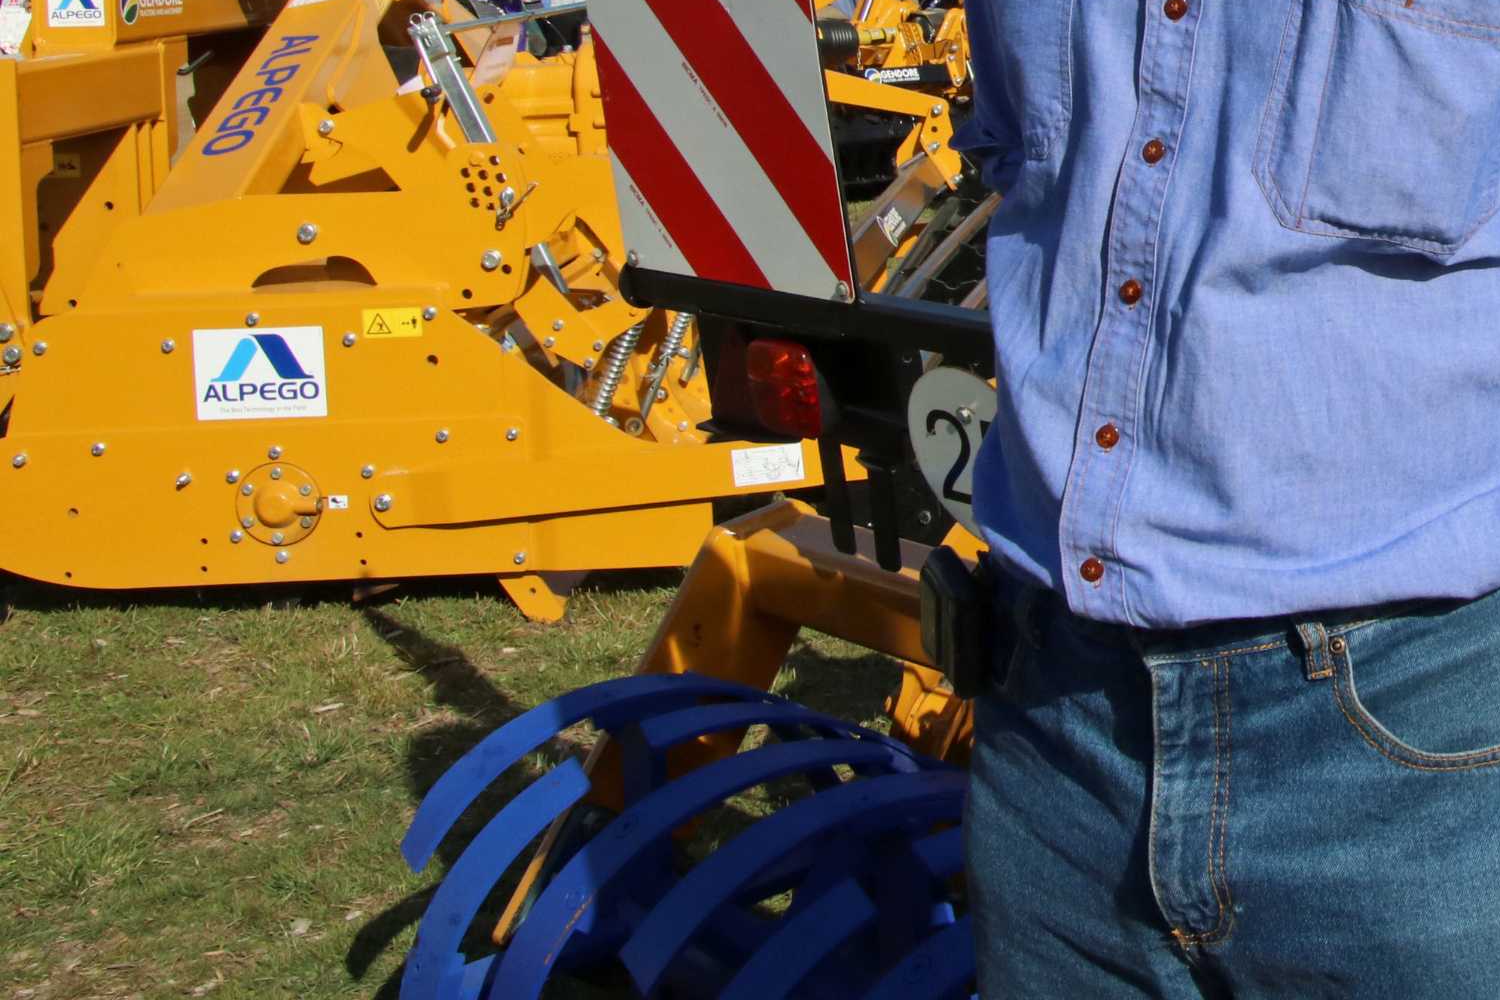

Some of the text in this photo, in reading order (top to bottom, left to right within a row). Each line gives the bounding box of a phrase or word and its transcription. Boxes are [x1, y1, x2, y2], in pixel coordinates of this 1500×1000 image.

[51, 10, 102, 20] ALPEGO
[202, 35, 319, 156] ALPEGO
[203, 381, 320, 403] ALPEGO
